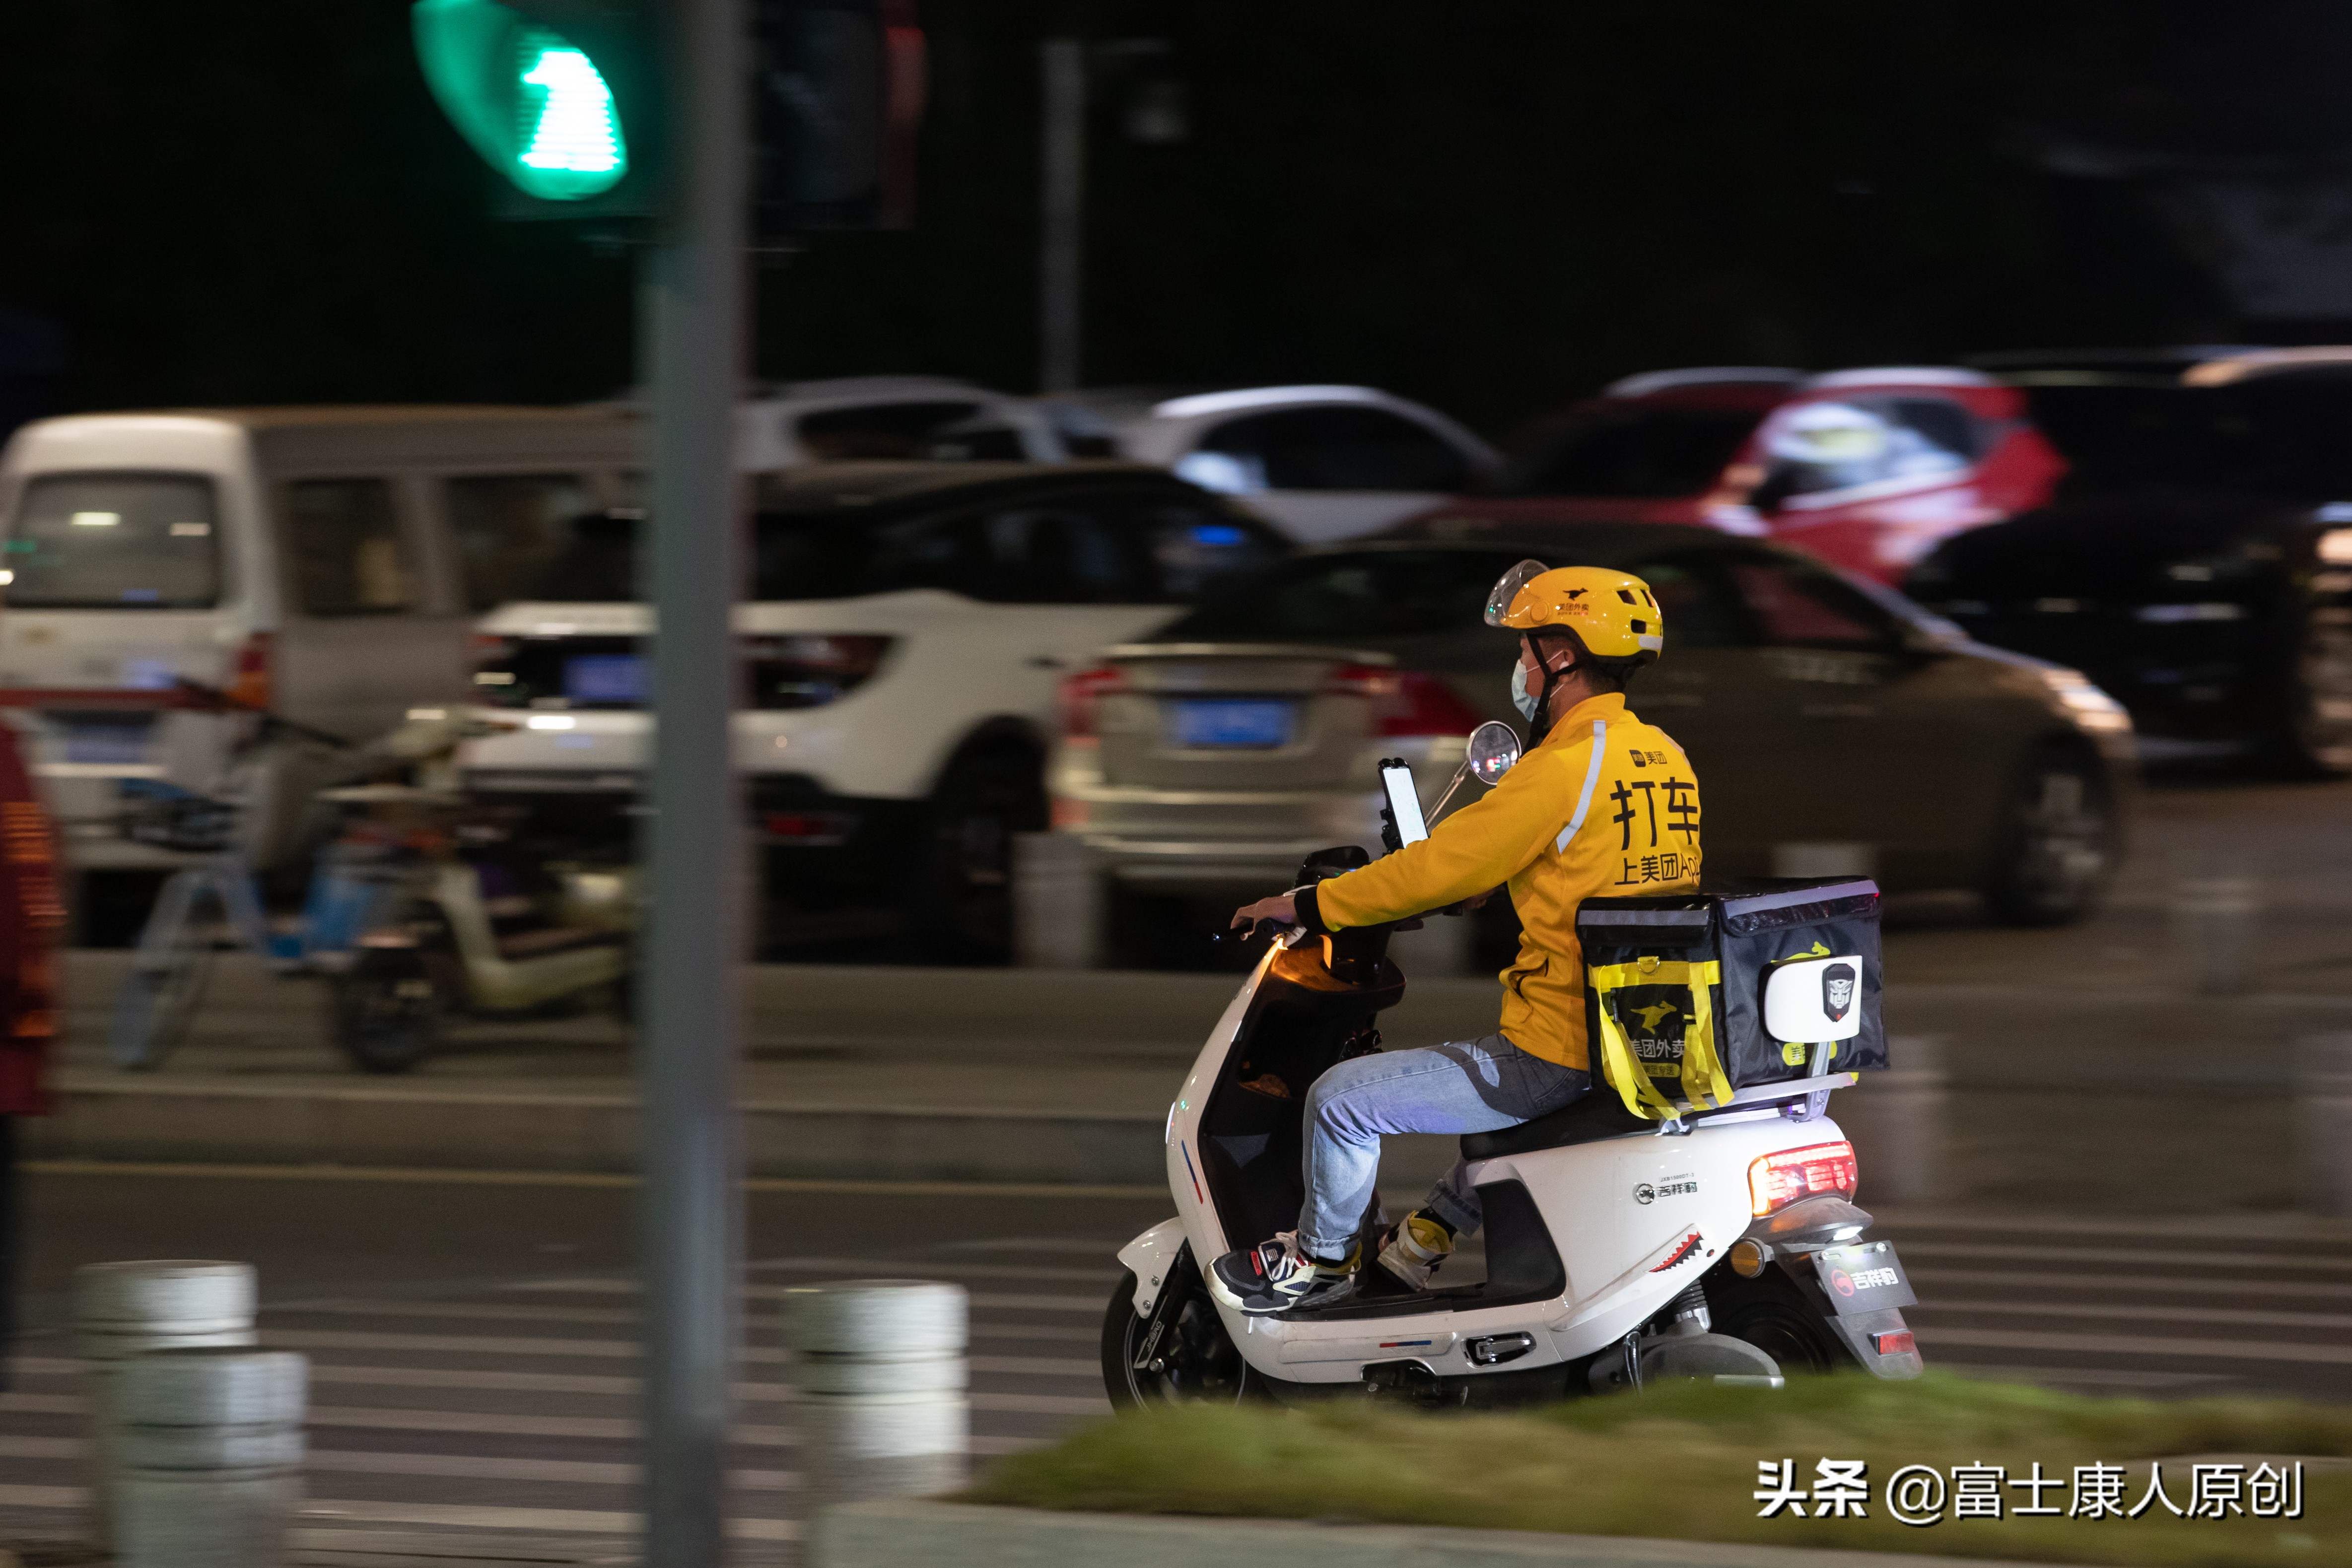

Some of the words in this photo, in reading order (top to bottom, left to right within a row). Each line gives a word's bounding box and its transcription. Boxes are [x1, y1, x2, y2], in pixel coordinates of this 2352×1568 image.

[1644, 751, 1667, 764] 美团
[1610, 776, 1699, 851] 打车
[1850, 1267, 1899, 1290] 吉祥豹
